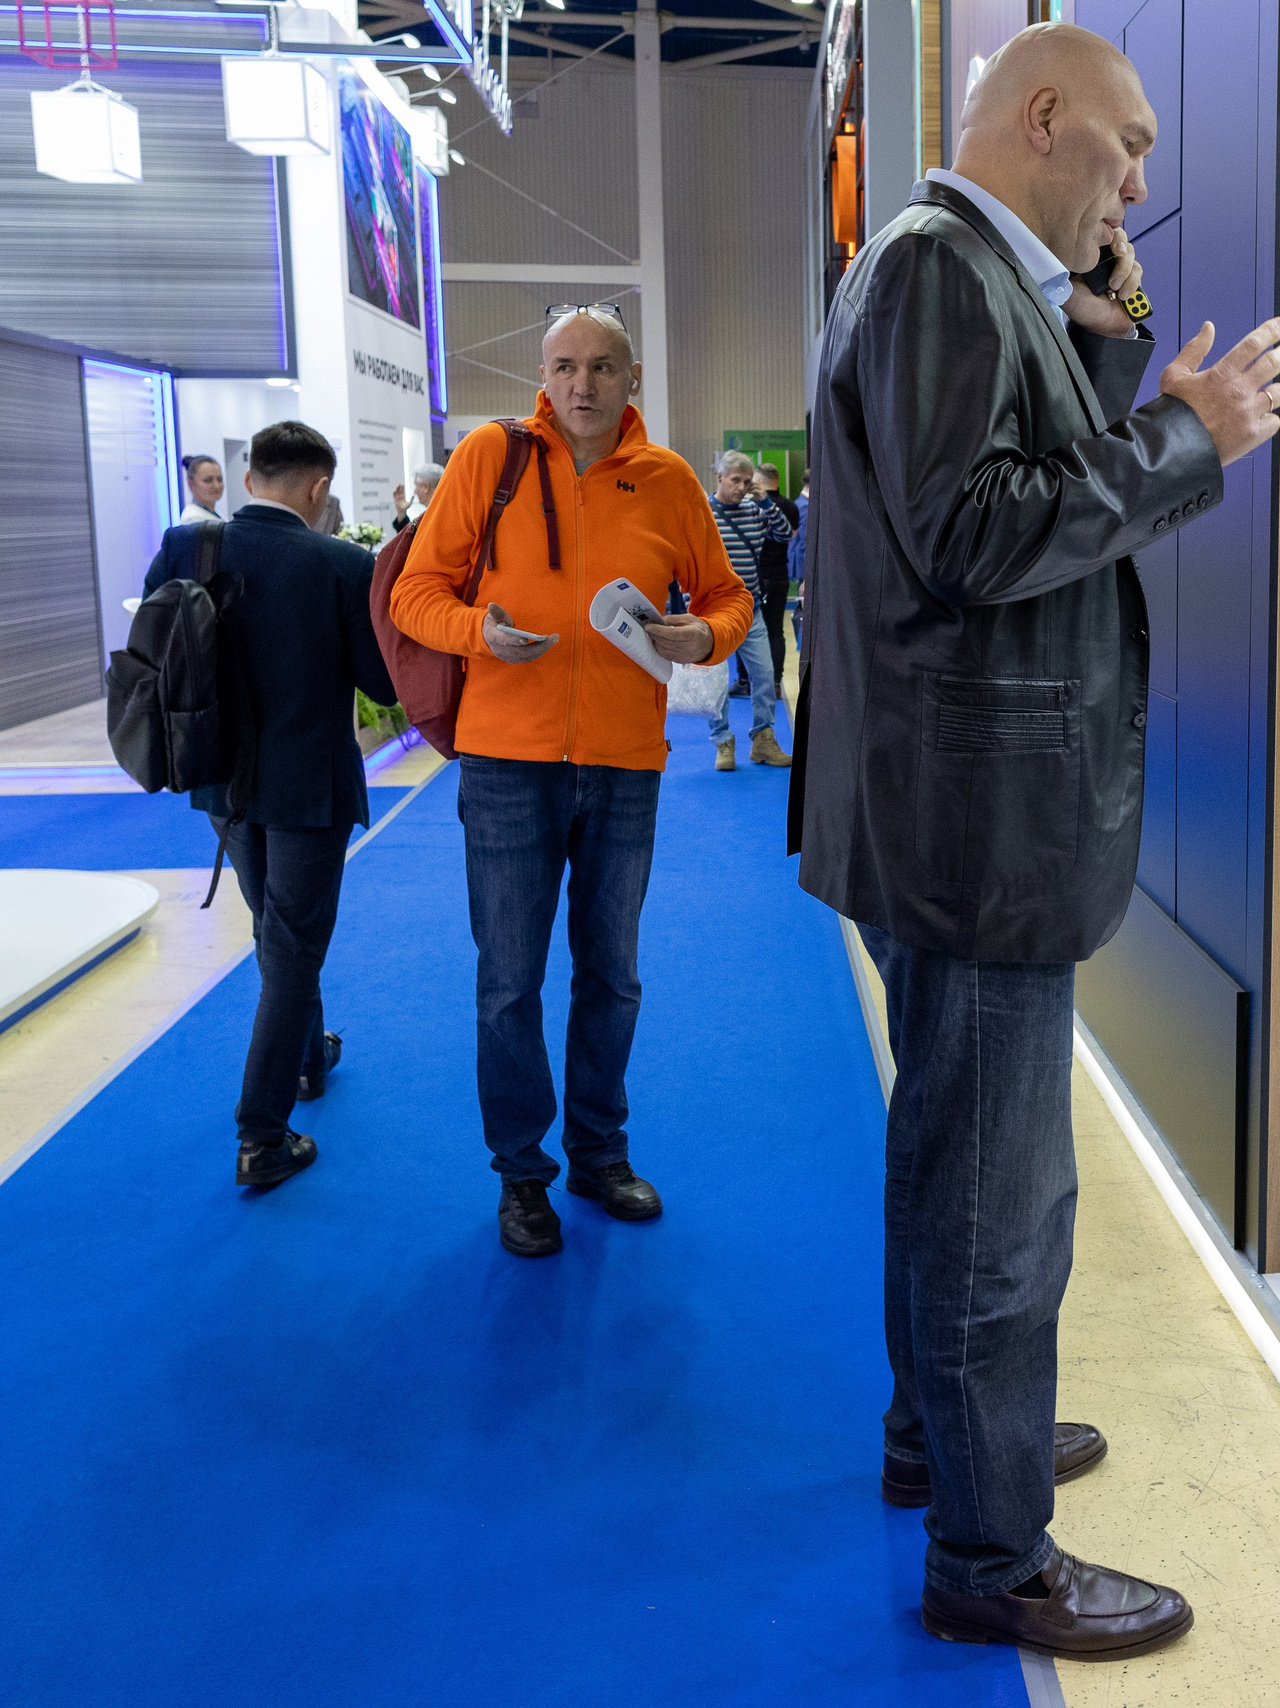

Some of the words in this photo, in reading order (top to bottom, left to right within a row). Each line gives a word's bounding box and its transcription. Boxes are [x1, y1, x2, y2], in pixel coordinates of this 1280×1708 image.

[353, 349, 366, 375] МЫ
[368, 355, 400, 385] РАБОТАЕМ
[401, 368, 413, 393] ДЛЯ
[616, 479, 635, 493] HH
